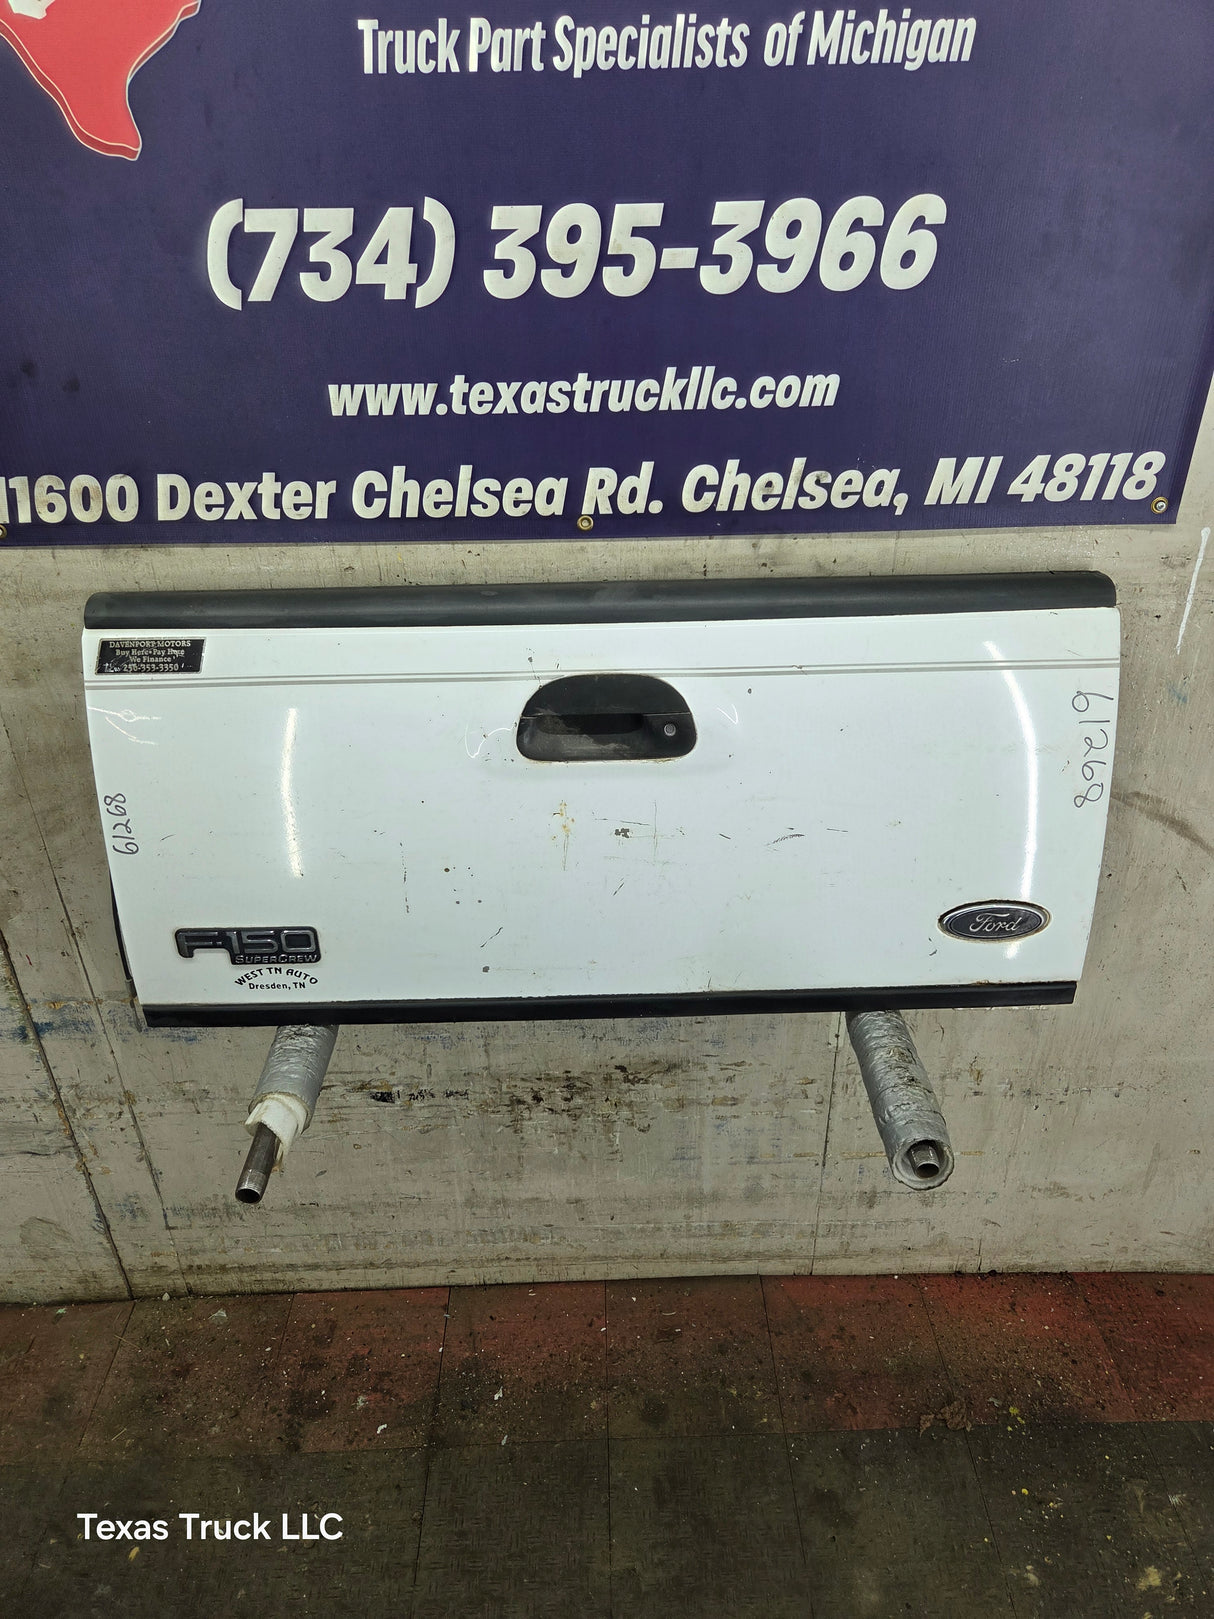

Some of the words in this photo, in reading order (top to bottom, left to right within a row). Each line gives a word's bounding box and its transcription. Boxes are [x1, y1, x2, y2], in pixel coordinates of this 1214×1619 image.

[358, 18, 460, 74] Truck
[469, 18, 546, 72] Part
[553, 14, 749, 78] Specialists
[763, 10, 805, 67] of
[806, 8, 977, 71] Michigan
[207, 196, 455, 310] (734)
[484, 194, 946, 299] 395-3966
[328, 366, 840, 416] www.texastruckllc.com
[157, 473, 336, 520] Dexter
[352, 465, 568, 518] Chelsea
[581, 462, 663, 514] Rd.
[682, 457, 908, 515] Chelsea,
[924, 456, 1003, 505] MI
[1007, 451, 1166, 501] 48118
[142, 655, 172, 663] Finance
[1071, 690, 1114, 809] 61268
[103, 792, 139, 855] 61268
[969, 912, 1022, 932] Ford
[234, 968, 264, 987] WEST
[265, 967, 282, 975] TN
[285, 968, 319, 985] AUTO
[248, 982, 291, 990] Dresden,
